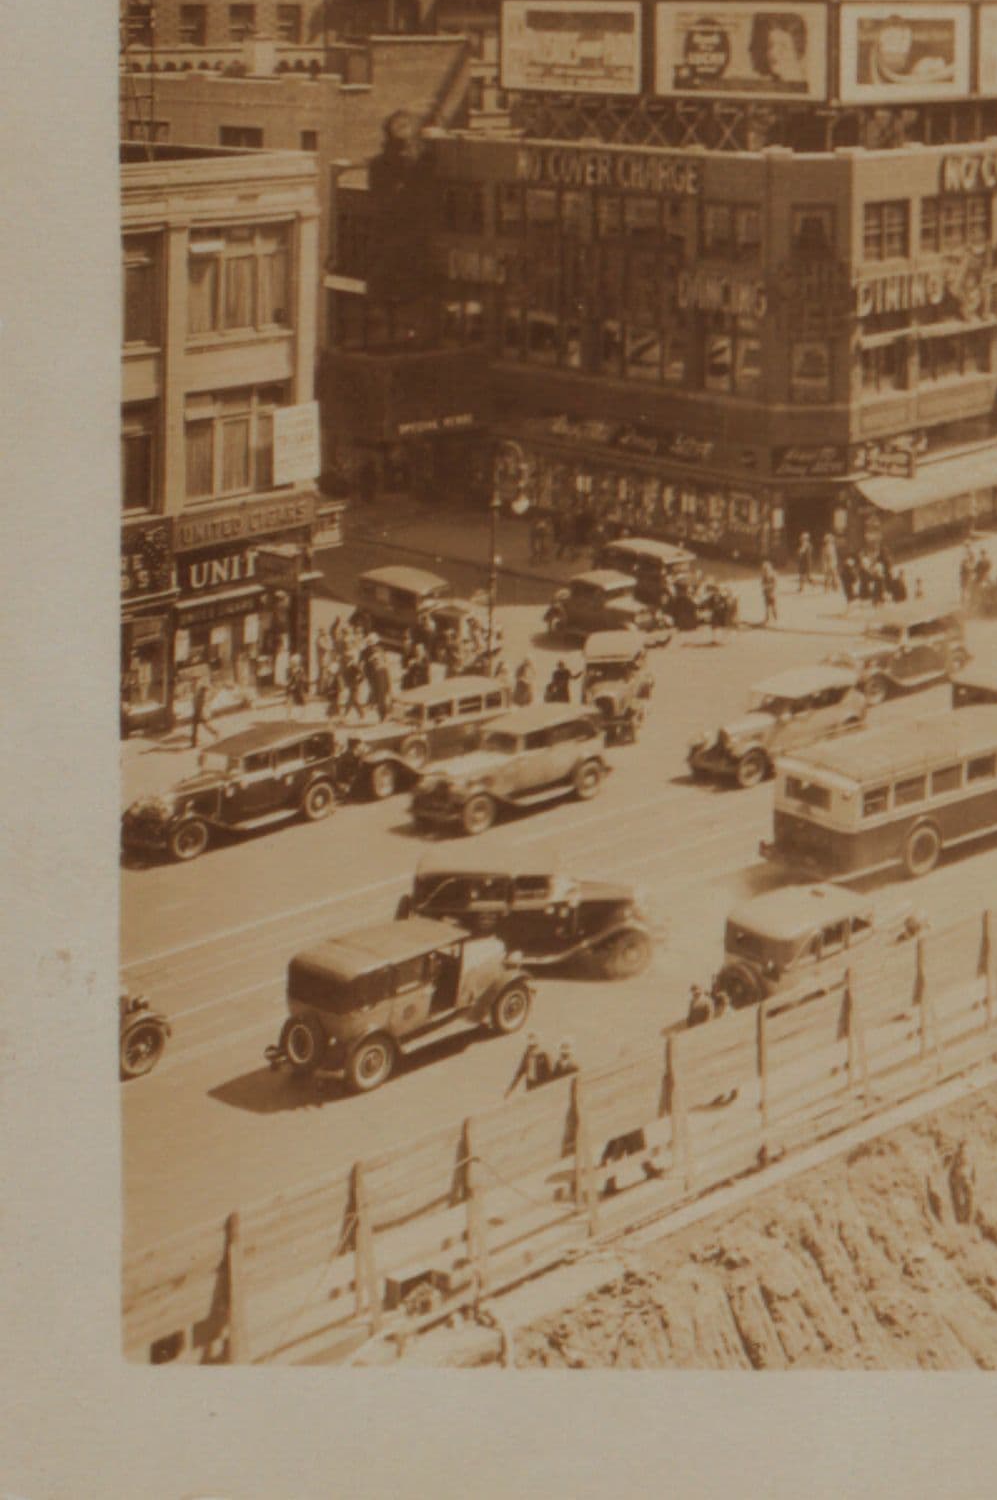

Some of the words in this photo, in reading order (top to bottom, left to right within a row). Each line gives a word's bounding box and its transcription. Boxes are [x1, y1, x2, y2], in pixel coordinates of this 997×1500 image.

[944, 155, 979, 192] NO
[856, 270, 944, 319] DINING
[182, 516, 242, 545] UNITED
[190, 550, 259, 589] UNIT
